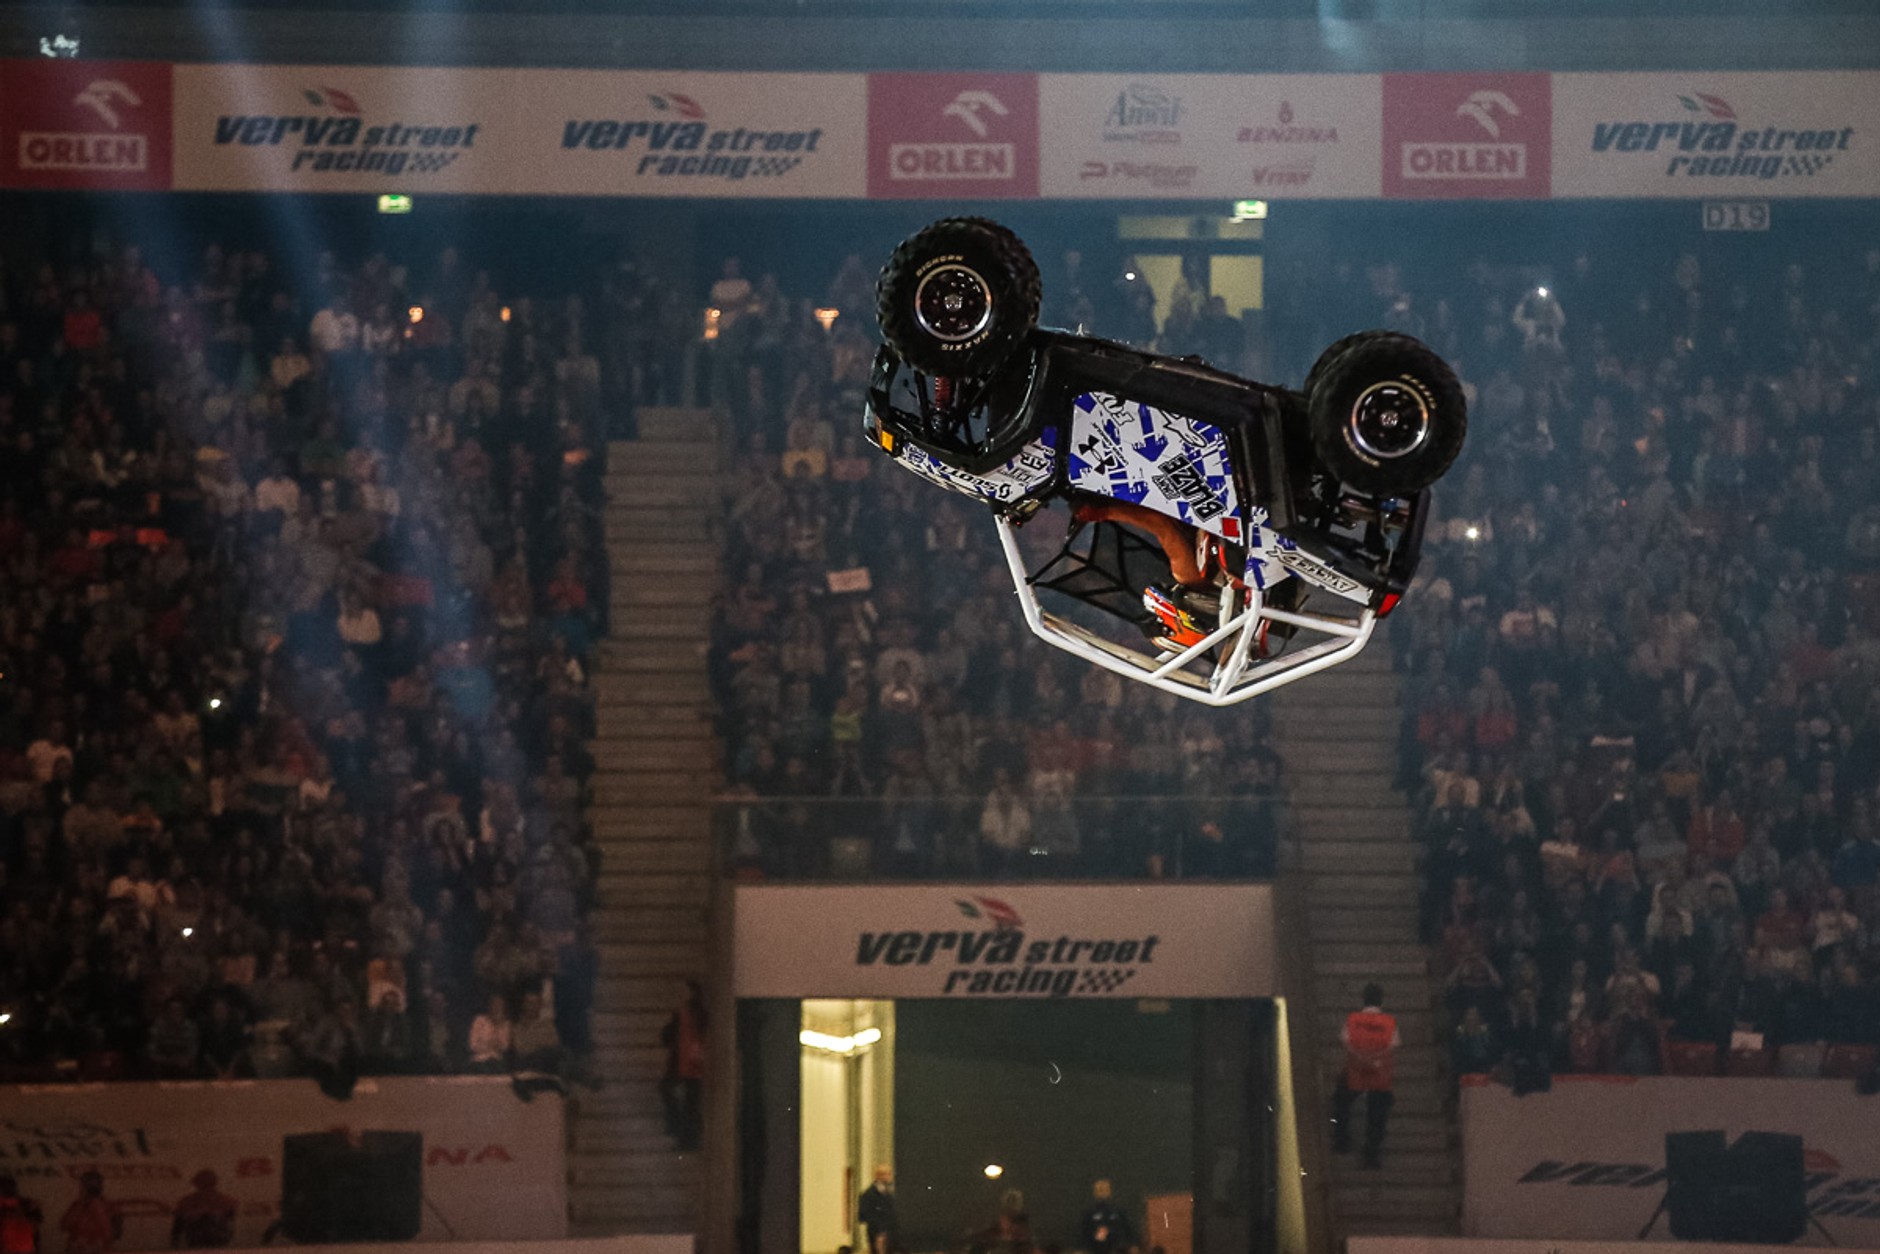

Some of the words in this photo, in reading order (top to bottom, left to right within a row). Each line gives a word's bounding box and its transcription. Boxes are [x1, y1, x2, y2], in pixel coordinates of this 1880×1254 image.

[213, 114, 362, 147] verva
[365, 123, 480, 150] street
[561, 118, 706, 151] verva
[709, 127, 823, 154] street
[1237, 126, 1339, 144] BENZINA
[1591, 119, 1738, 152] verva
[1738, 126, 1854, 153] street
[26, 137, 139, 166] ORLEN
[292, 149, 410, 176] racing
[900, 148, 1006, 176] ORLEN
[1408, 147, 1519, 175] ORLEN
[637, 152, 754, 180] racing
[1667, 152, 1779, 180] racing
[1706, 204, 1767, 229] D19
[940, 330, 990, 352] MAXXIS
[1158, 454, 1226, 522] BLAZE
[856, 929, 1024, 965] verva
[1026, 935, 1160, 964] street
[944, 965, 1081, 997] racing
